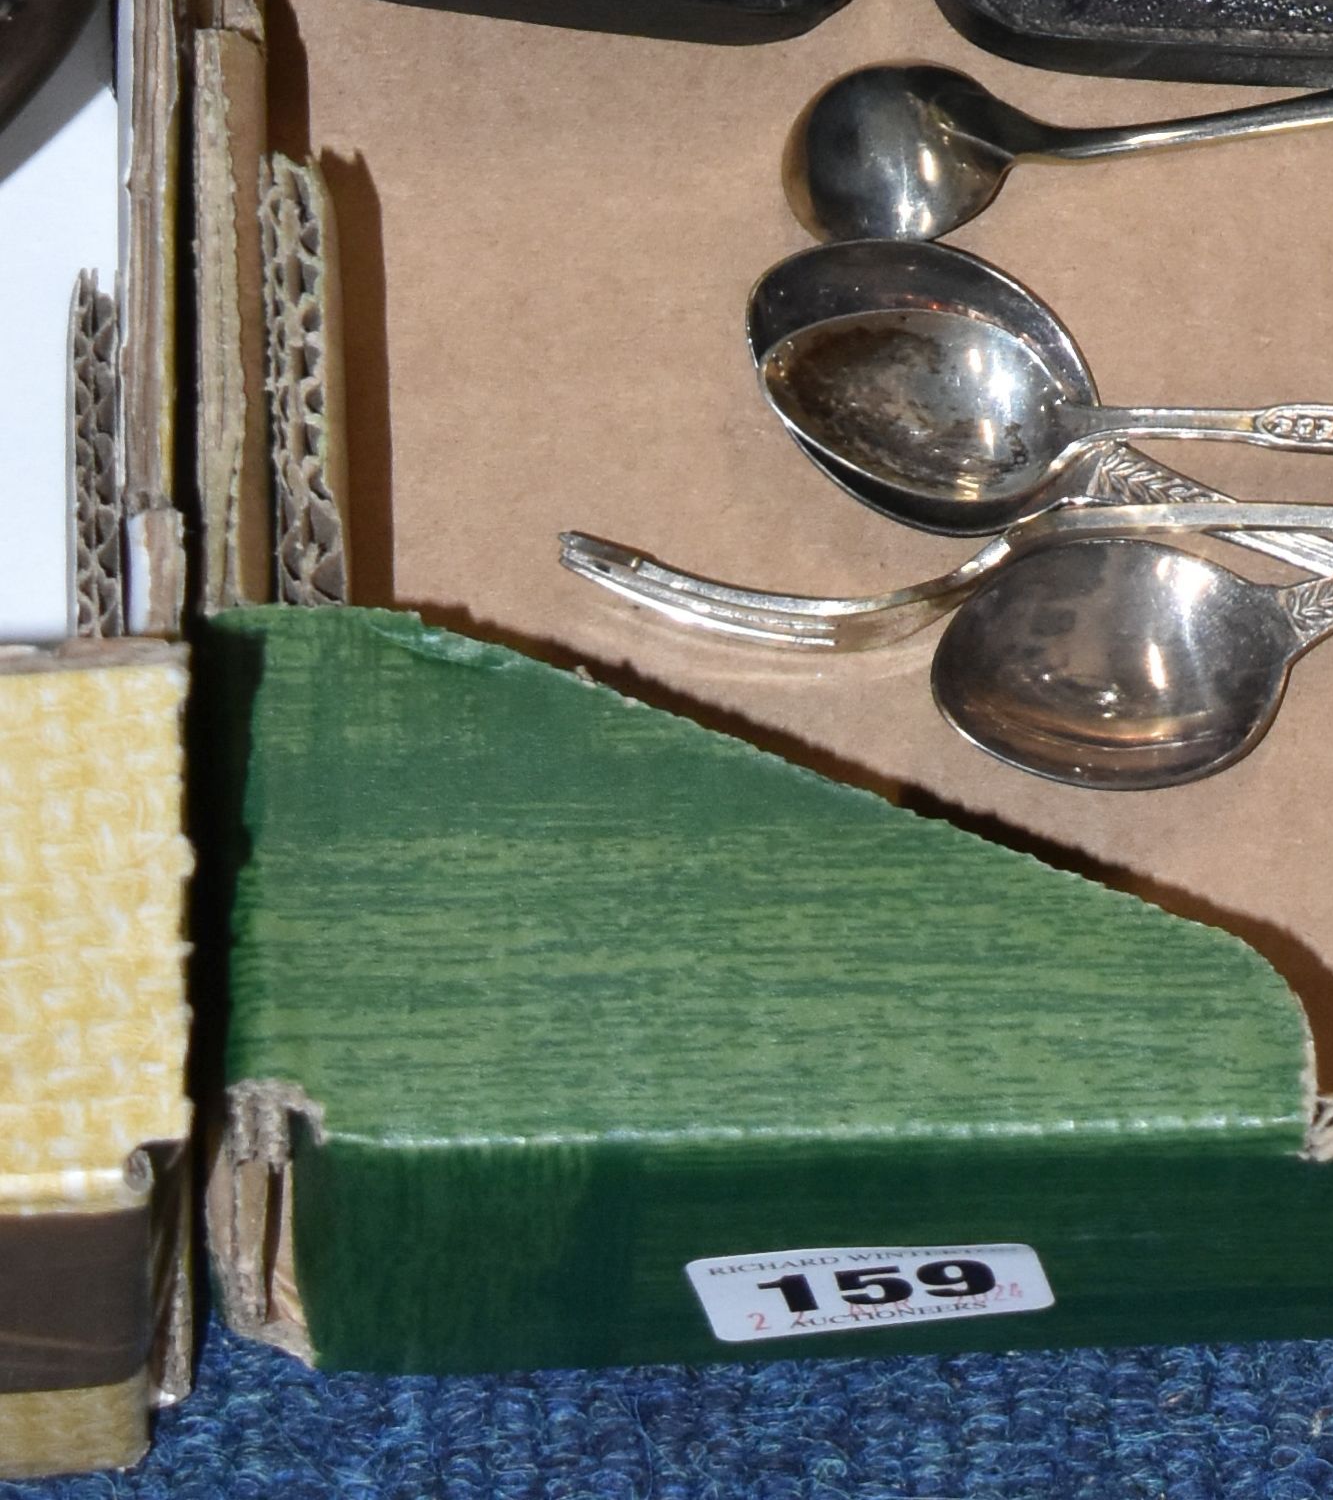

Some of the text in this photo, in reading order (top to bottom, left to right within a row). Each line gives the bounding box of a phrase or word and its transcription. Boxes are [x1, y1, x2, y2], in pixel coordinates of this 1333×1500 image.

[708, 1255, 839, 1276] RICHARD
[757, 1259, 996, 1313] 159
[790, 1301, 988, 1329] AUCTIONEERS
